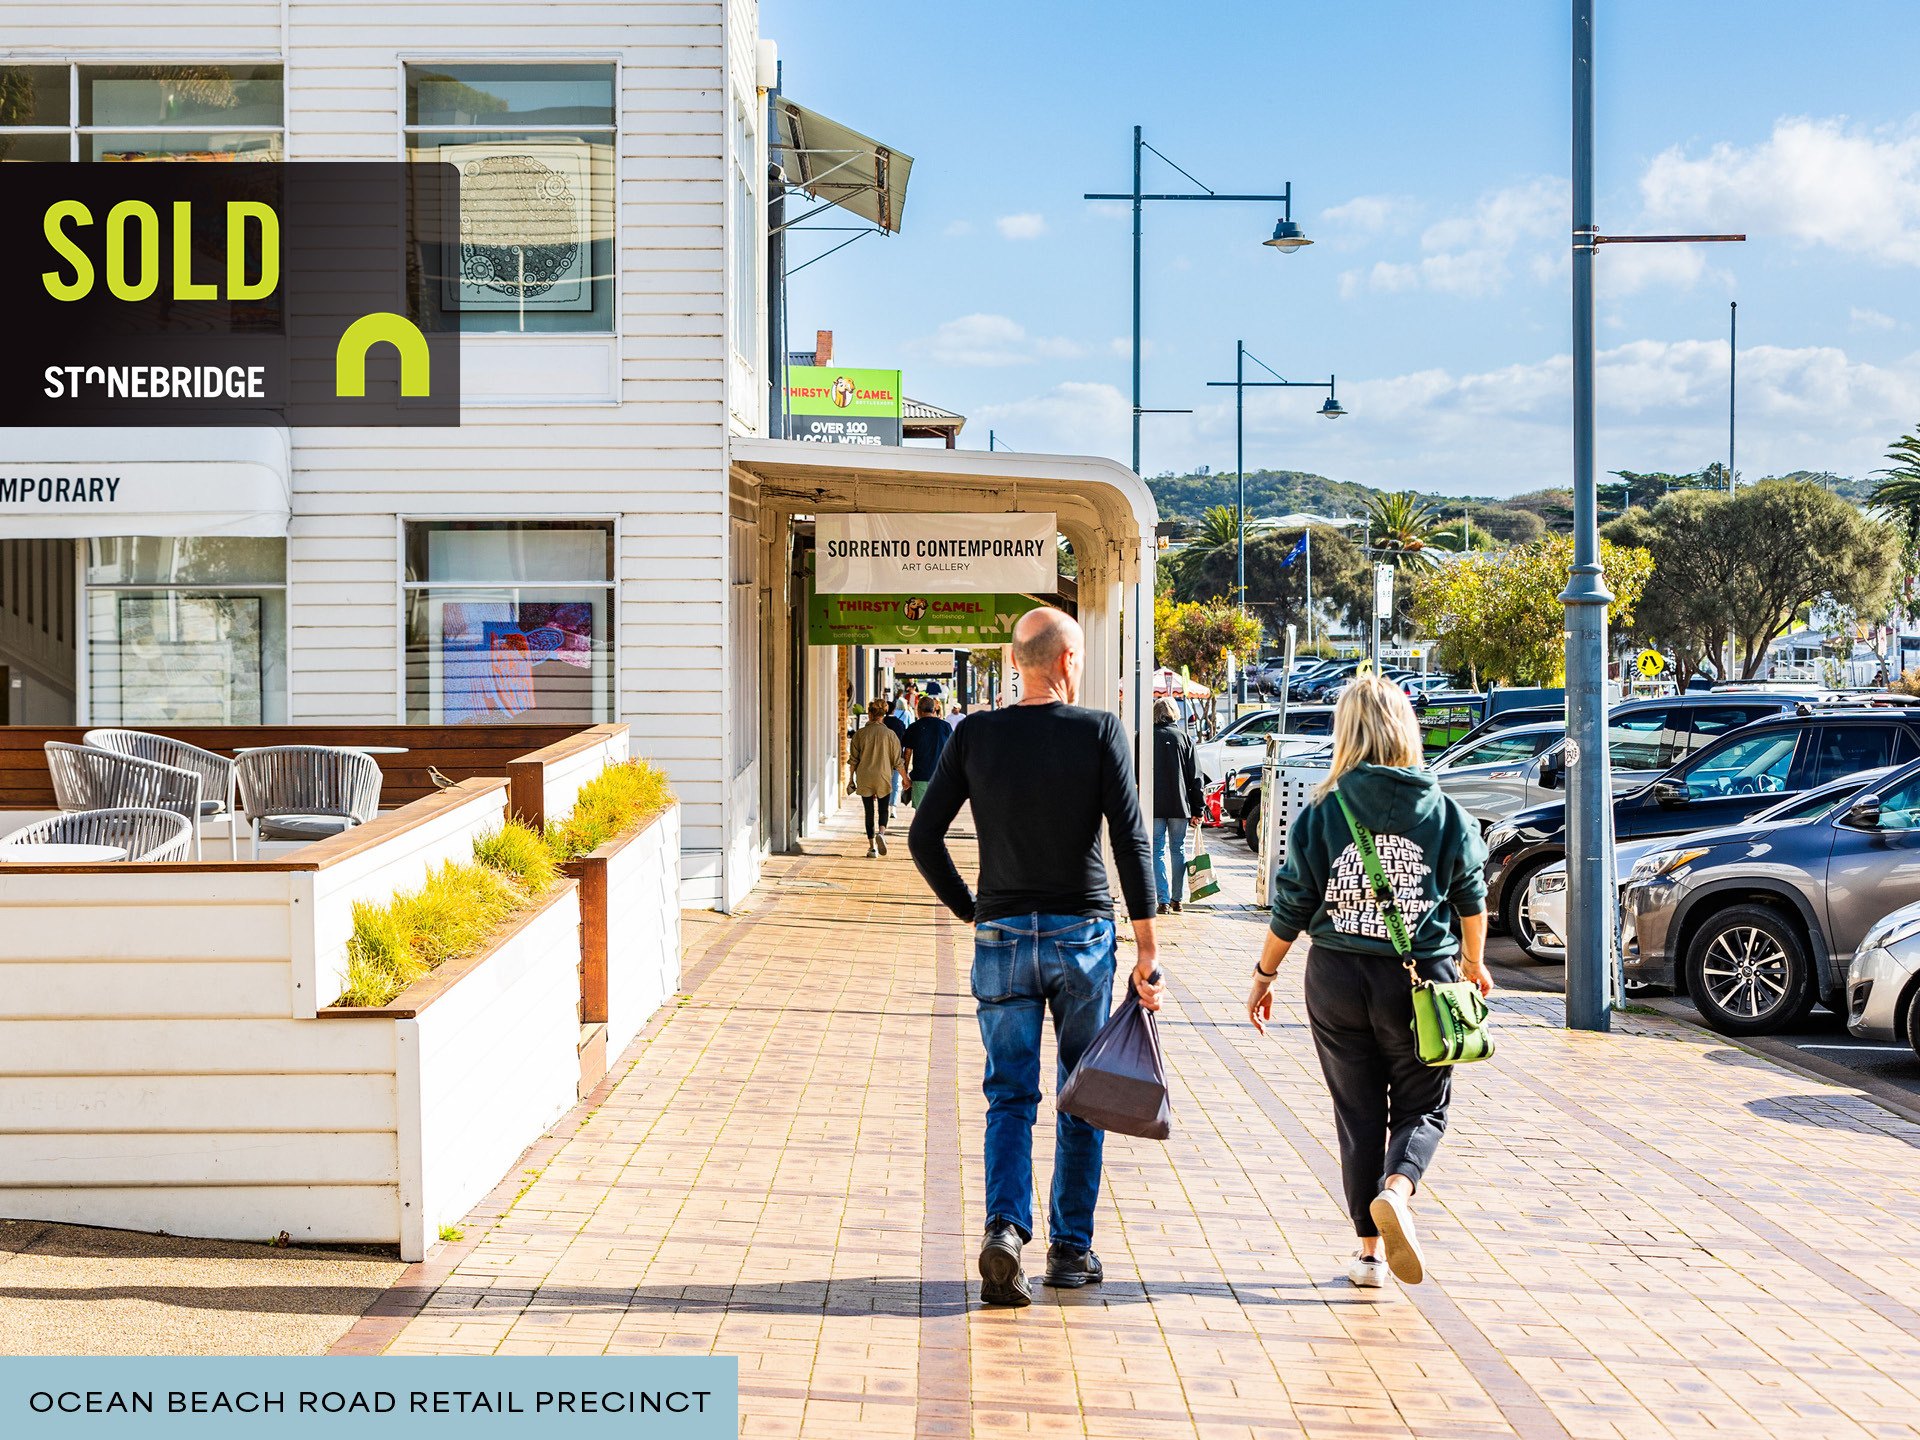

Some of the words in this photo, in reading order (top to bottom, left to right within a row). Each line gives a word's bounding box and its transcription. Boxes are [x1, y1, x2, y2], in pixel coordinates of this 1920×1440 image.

[856, 389, 893, 400] CAMEL
[811, 422, 844, 434] OVER
[846, 422, 868, 434] 100
[827, 539, 910, 558] SORRENTO
[916, 539, 1045, 558] CONTEMPORARY
[901, 563, 922, 571] ART
[924, 563, 970, 571] GALLERY
[837, 600, 901, 613] THIRSTY
[932, 601, 984, 613] CAMEL
[1337, 862, 1366, 877] ELIT
